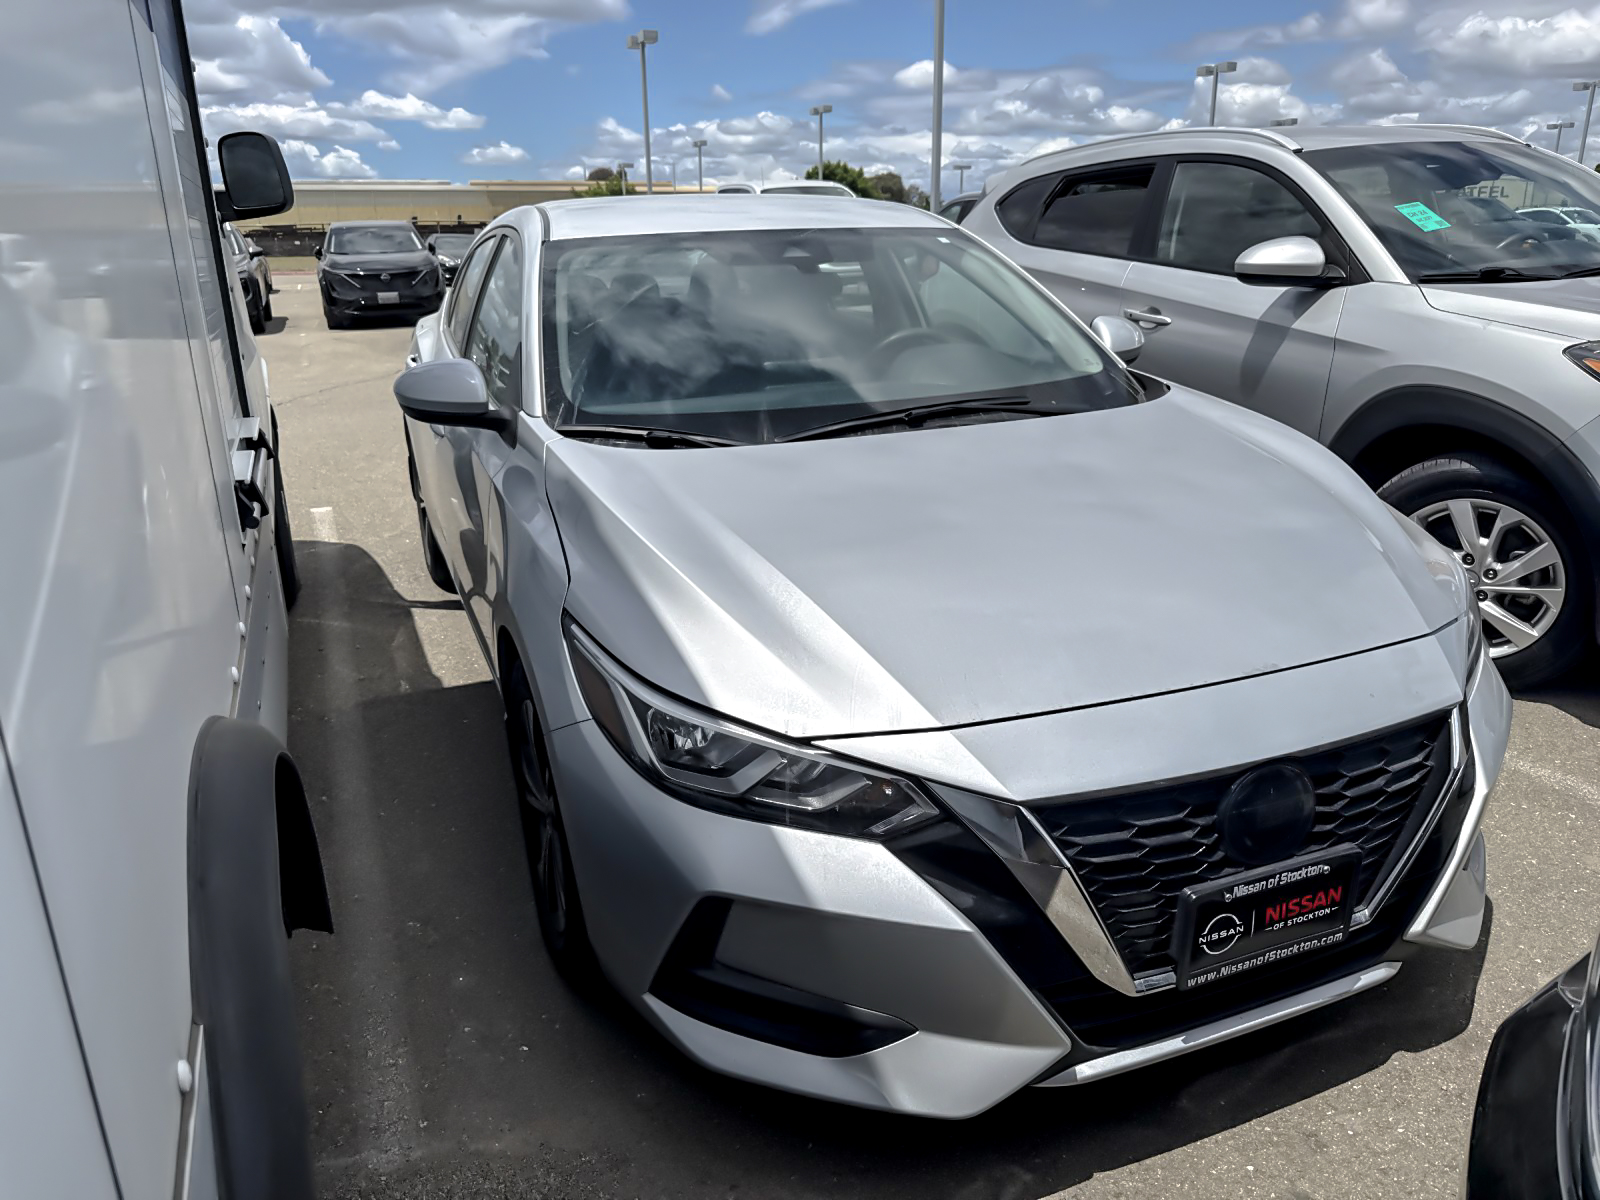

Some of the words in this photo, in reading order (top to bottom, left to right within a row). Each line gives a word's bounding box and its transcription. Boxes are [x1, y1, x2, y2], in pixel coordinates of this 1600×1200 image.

[1232, 880, 1266, 898] Nissan
[1267, 874, 1280, 889] of
[1280, 864, 1323, 885] Stockton
[1265, 886, 1342, 926] NISSAN
[1273, 921, 1285, 930] OF
[1287, 907, 1331, 926] STOCKTON
[1199, 925, 1244, 944] NISSAN
[1187, 932, 1343, 987] www.NissanofStockton.com
